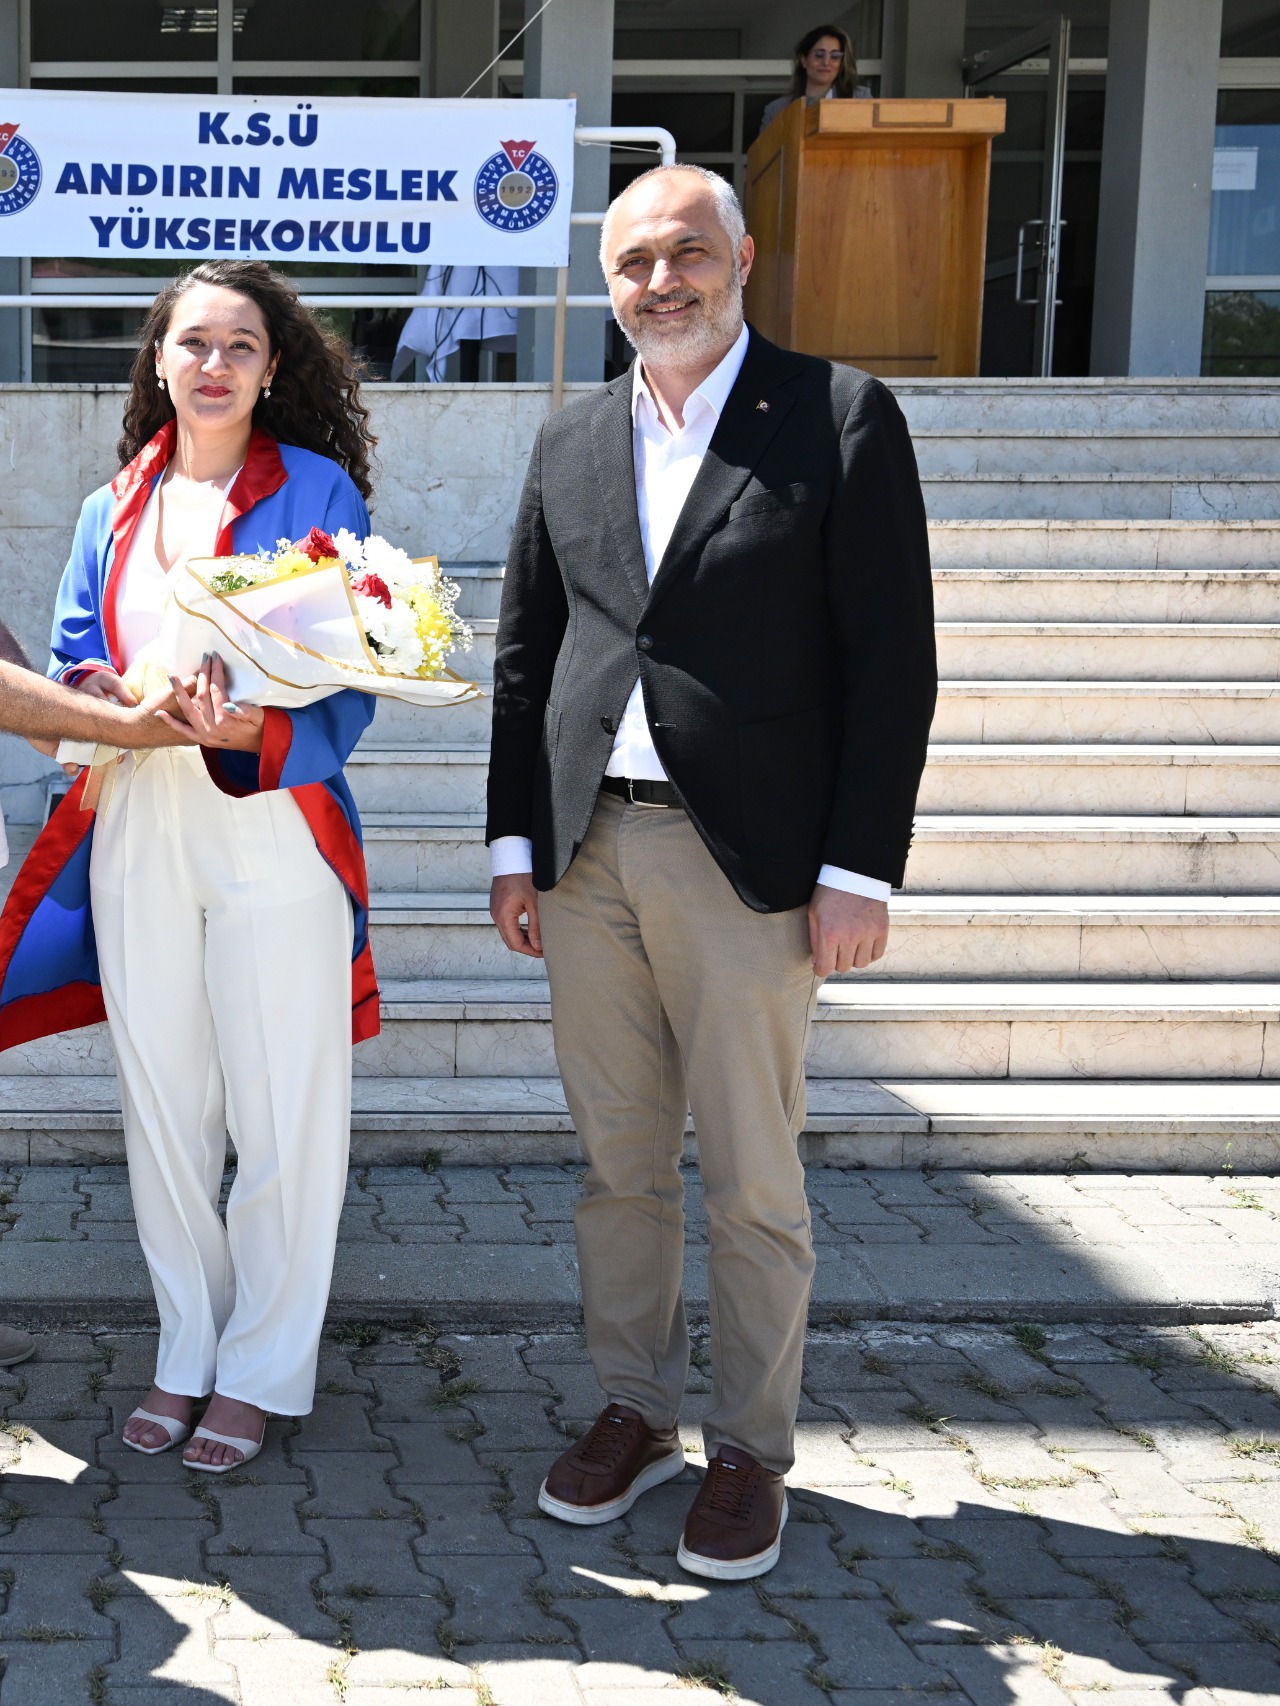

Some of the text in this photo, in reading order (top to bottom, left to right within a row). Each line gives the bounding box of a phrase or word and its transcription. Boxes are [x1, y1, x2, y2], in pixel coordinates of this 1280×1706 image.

[199, 103, 319, 148] K.S.Ü
[55, 163, 459, 202] ANDIRIN MESLEK
[488, 163, 545, 219] KAHRAMANMARAŞ
[501, 186, 533, 194] 1992
[89, 207, 432, 254] YÜKSEKOKULU
